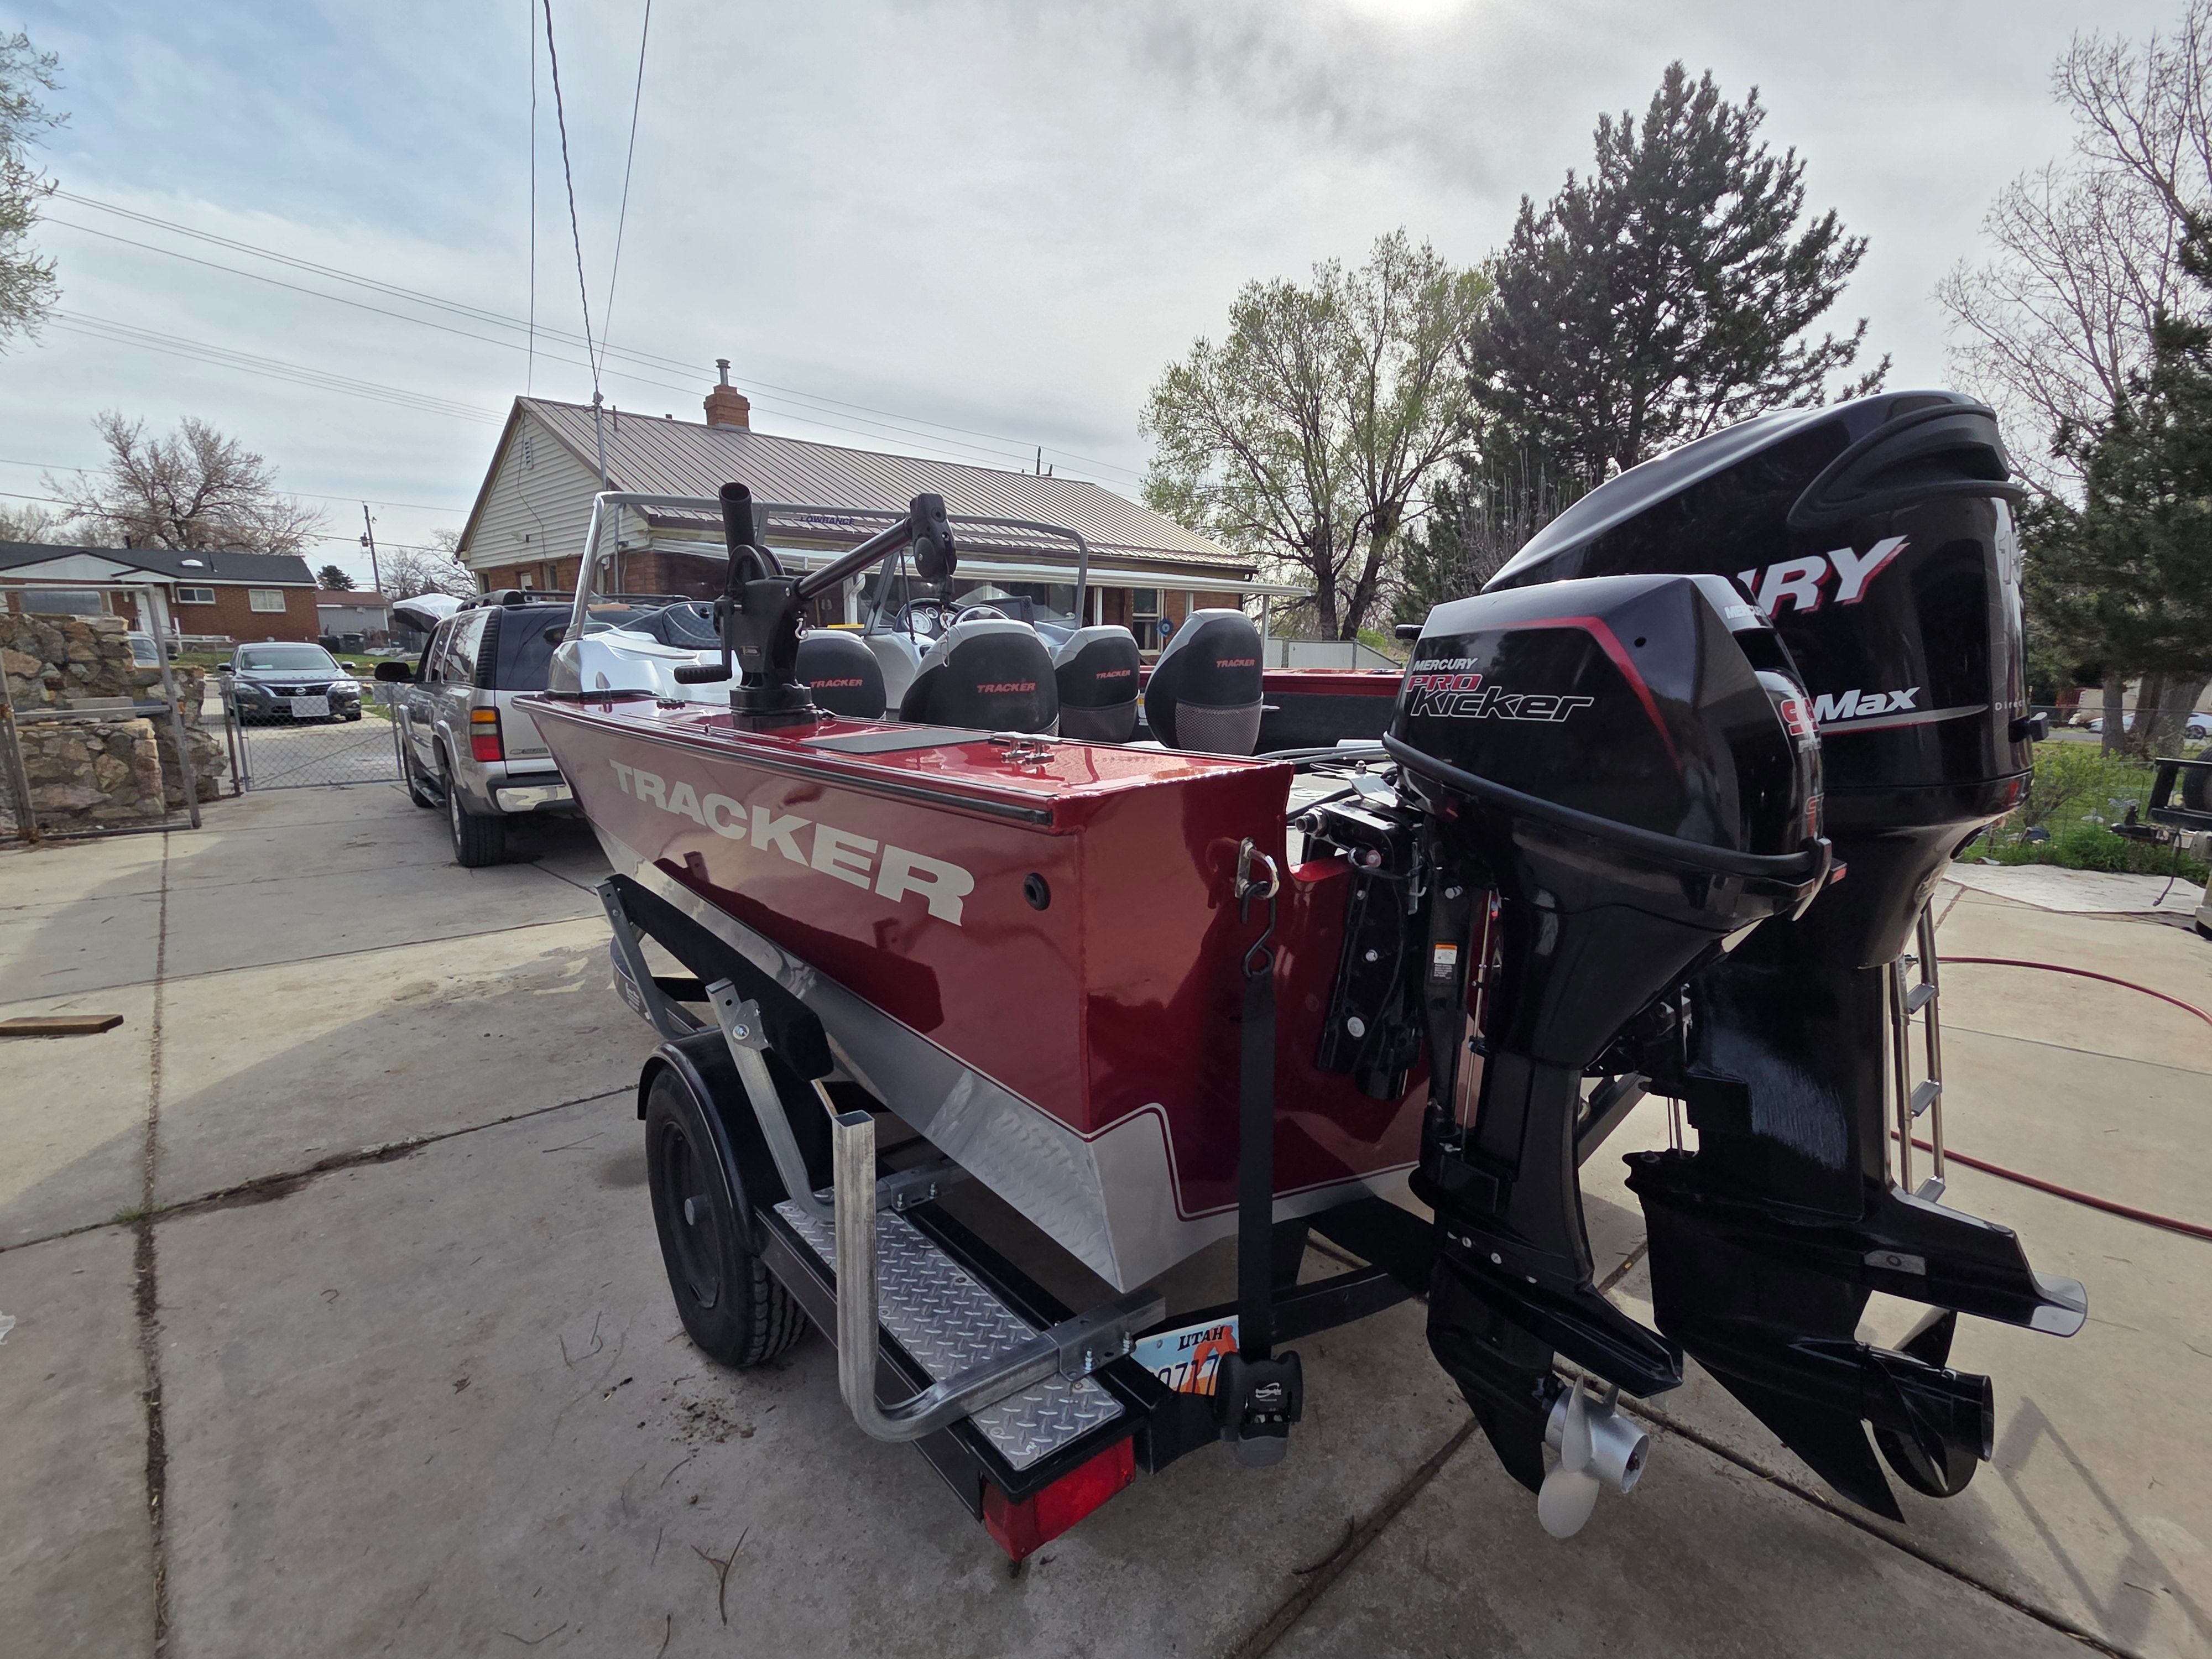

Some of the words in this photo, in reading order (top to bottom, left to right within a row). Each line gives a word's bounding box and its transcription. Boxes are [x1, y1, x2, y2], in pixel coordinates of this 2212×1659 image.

[800, 515, 855, 525] LOWRANCE
[1216, 659, 1255, 668] TRACKER
[1412, 658, 1479, 672] MERCURY
[1095, 669, 1131, 680] TRACKER
[810, 678, 863, 689] TRACKER
[977, 682, 1036, 694] TRACKER
[1405, 674, 1483, 692] PRO
[1410, 686, 1595, 722] Kicker
[609, 759, 975, 926] TRACKER
[1177, 1325, 1225, 1351] UTAH
